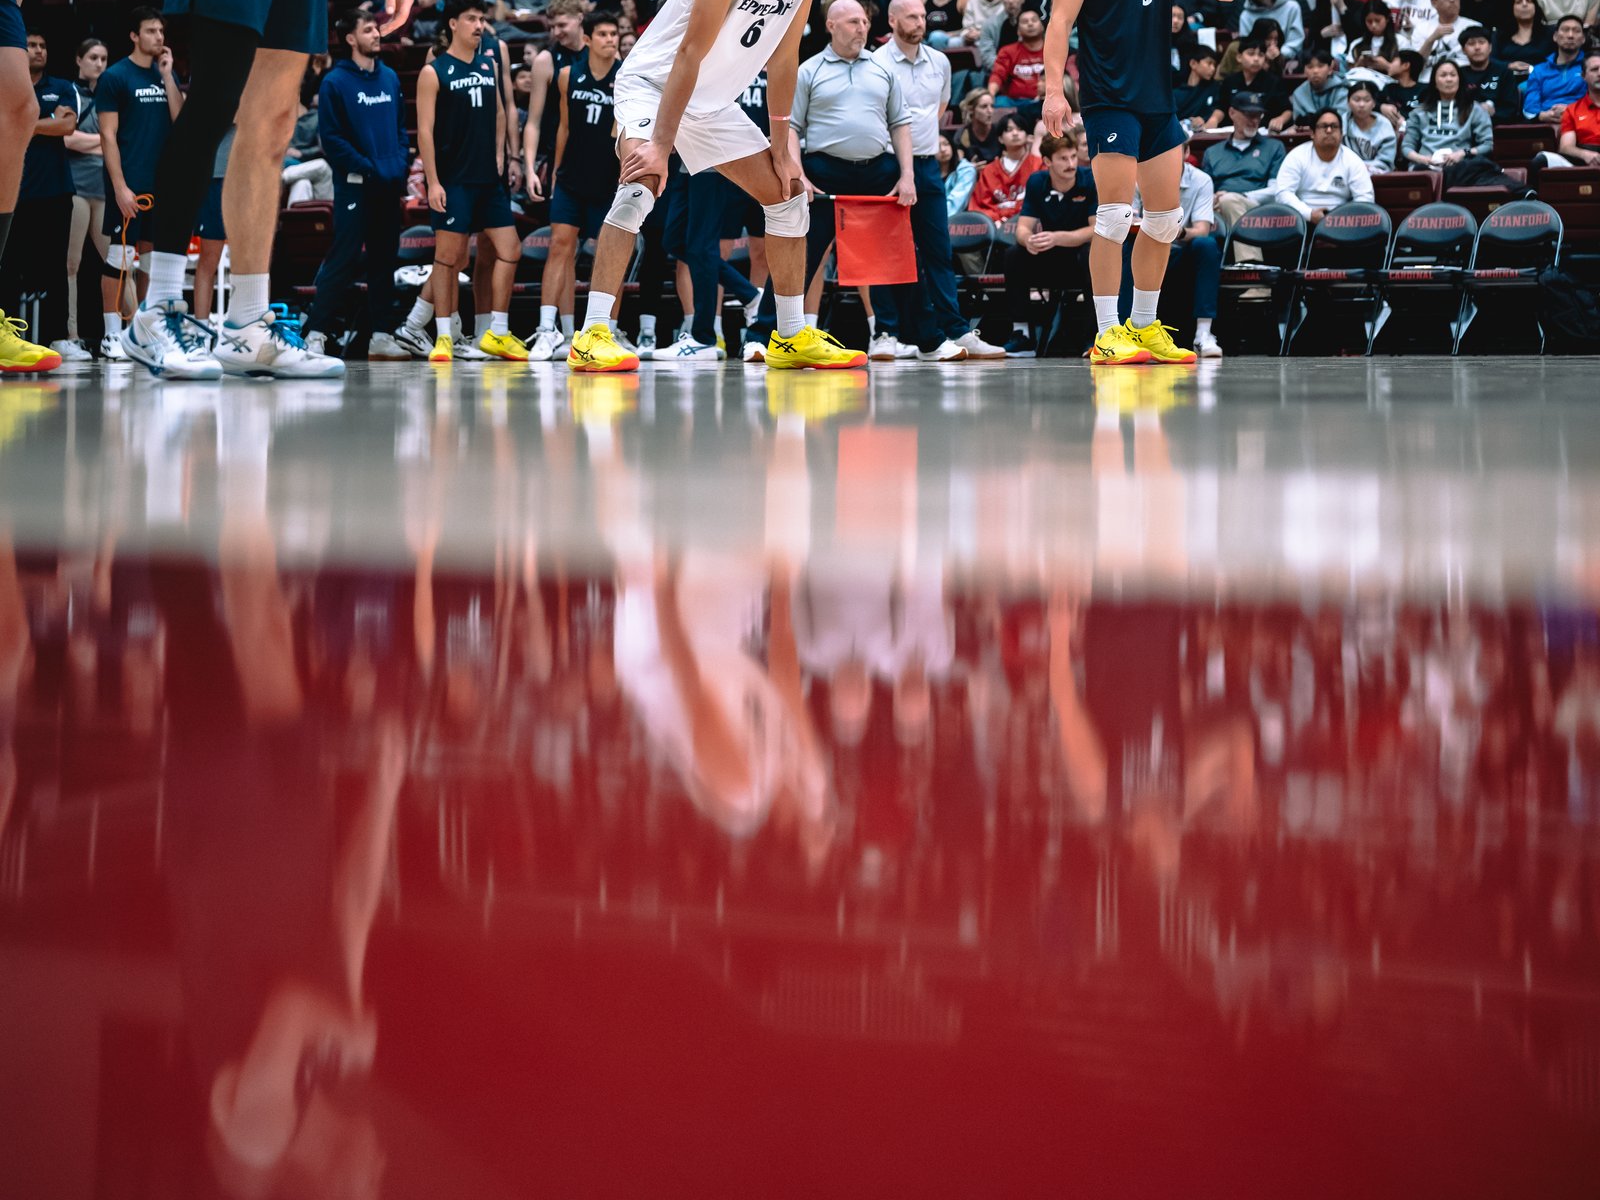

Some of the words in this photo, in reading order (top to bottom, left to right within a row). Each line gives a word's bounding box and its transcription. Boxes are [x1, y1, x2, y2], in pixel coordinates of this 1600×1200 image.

[740, 18, 765, 48] 6
[450, 72, 495, 90] PEPPERDINE
[468, 87, 482, 107] 11
[571, 88, 614, 105] PEPPERDIN
[742, 87, 762, 108] 44
[1241, 215, 1296, 229] STANFORD
[1325, 213, 1381, 228] STANFORD
[1408, 215, 1466, 230] STANFORD
[1491, 212, 1551, 228] STANFORD
[525, 236, 551, 248] STAN
[1304, 271, 1348, 280] CARDINAL
[1389, 270, 1434, 280] CARDINAL
